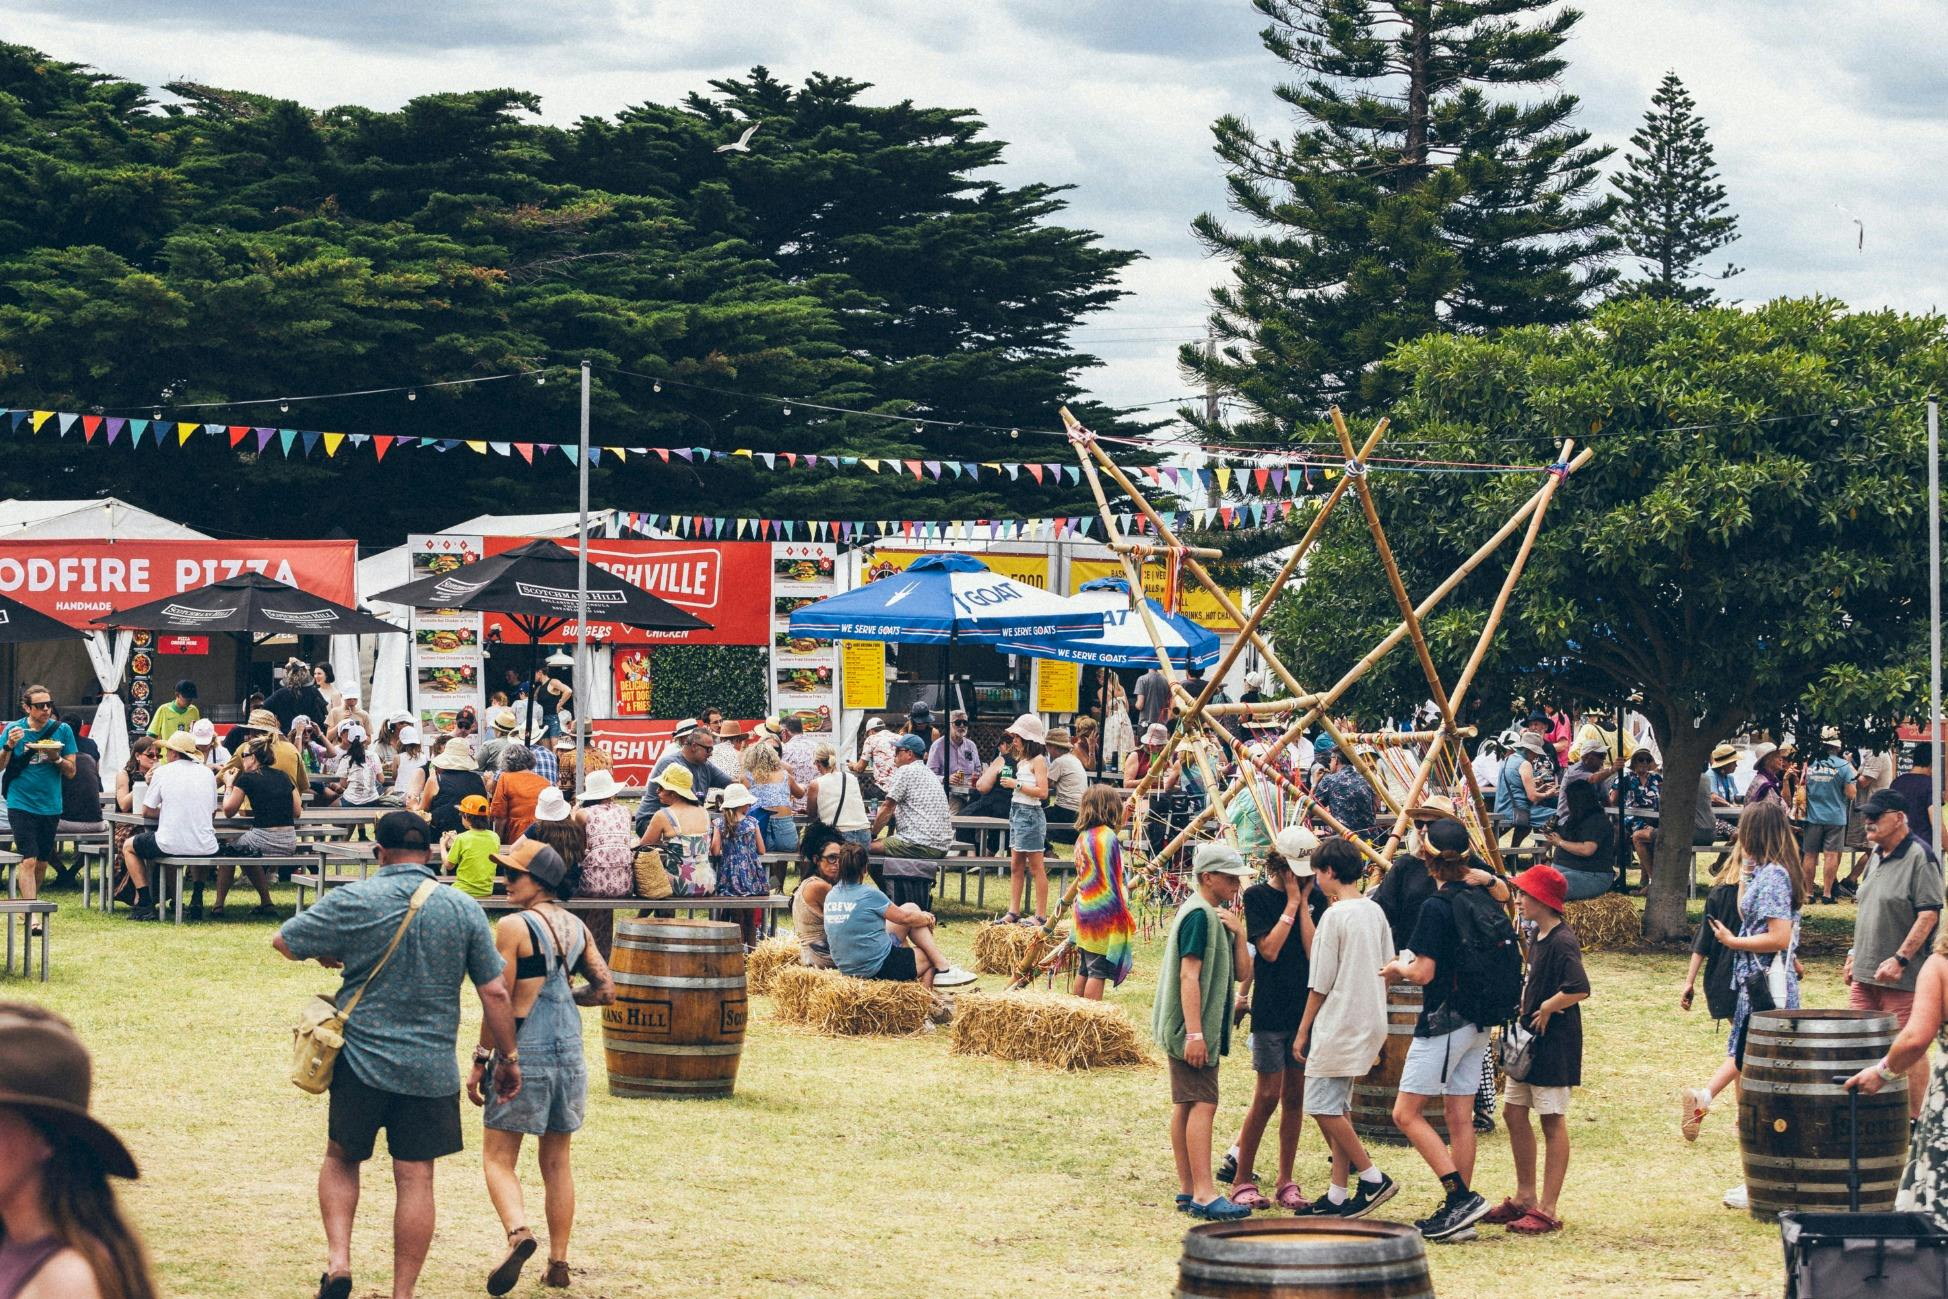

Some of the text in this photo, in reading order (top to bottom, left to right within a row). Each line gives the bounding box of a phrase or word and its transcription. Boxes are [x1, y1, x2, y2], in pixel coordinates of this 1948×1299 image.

[0, 557, 150, 592] ODFIRE
[593, 591, 620, 601] HILL
[964, 582, 1023, 607] GOAT
[56, 601, 112, 611] HANDMADE
[562, 625, 612, 637] BUGERS
[841, 623, 901, 635] WE SERVE GOATS
[1002, 625, 1056, 637] WE SERVE GOATS
[1058, 648, 1127, 663] WE SERVE GOATS
[621, 690, 634, 701] HOT
[632, 701, 651, 711] FRIES
[627, 1008, 666, 1027] HILL
